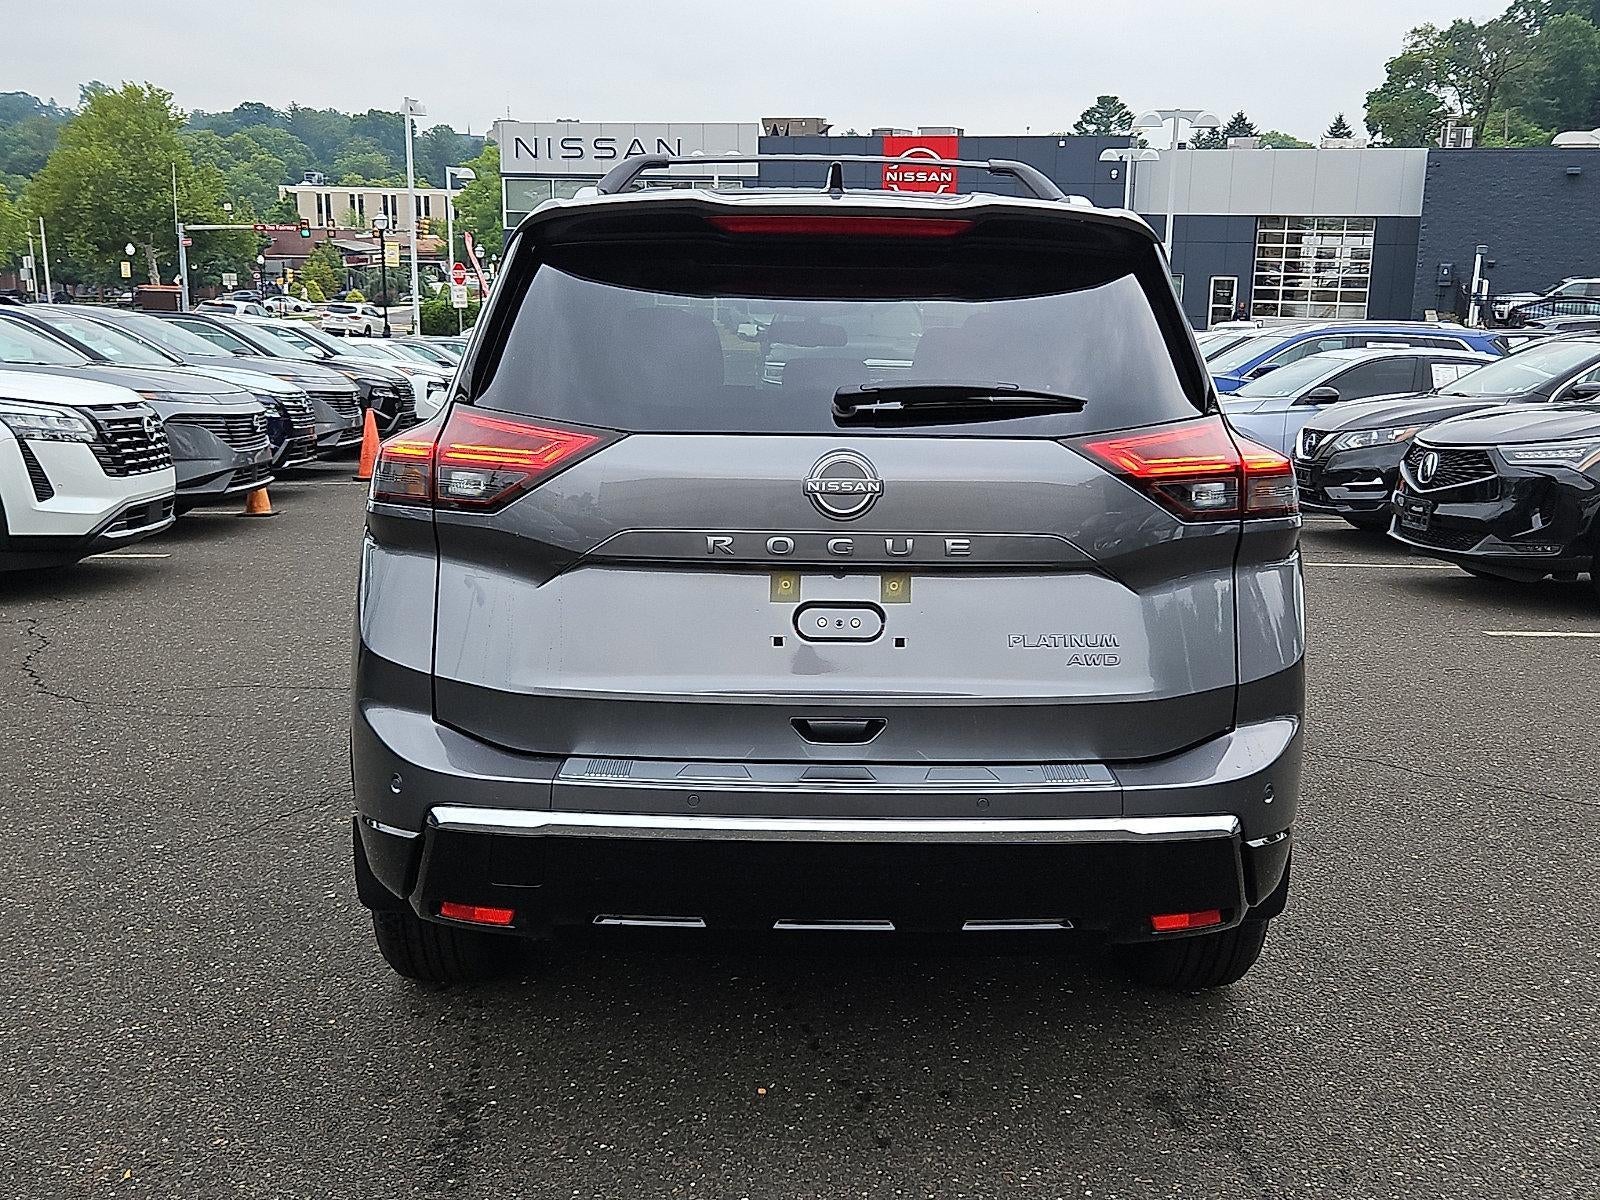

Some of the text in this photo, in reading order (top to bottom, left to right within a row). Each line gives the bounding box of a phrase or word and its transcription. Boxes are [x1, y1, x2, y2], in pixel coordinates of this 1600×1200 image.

[514, 136, 682, 161] NISSAN
[886, 171, 952, 182] NISSAN
[807, 481, 880, 492] NISSAN
[706, 535, 971, 557] ROGUE
[1007, 633, 1120, 648] PLATINUM
[1066, 653, 1121, 667] AWD
